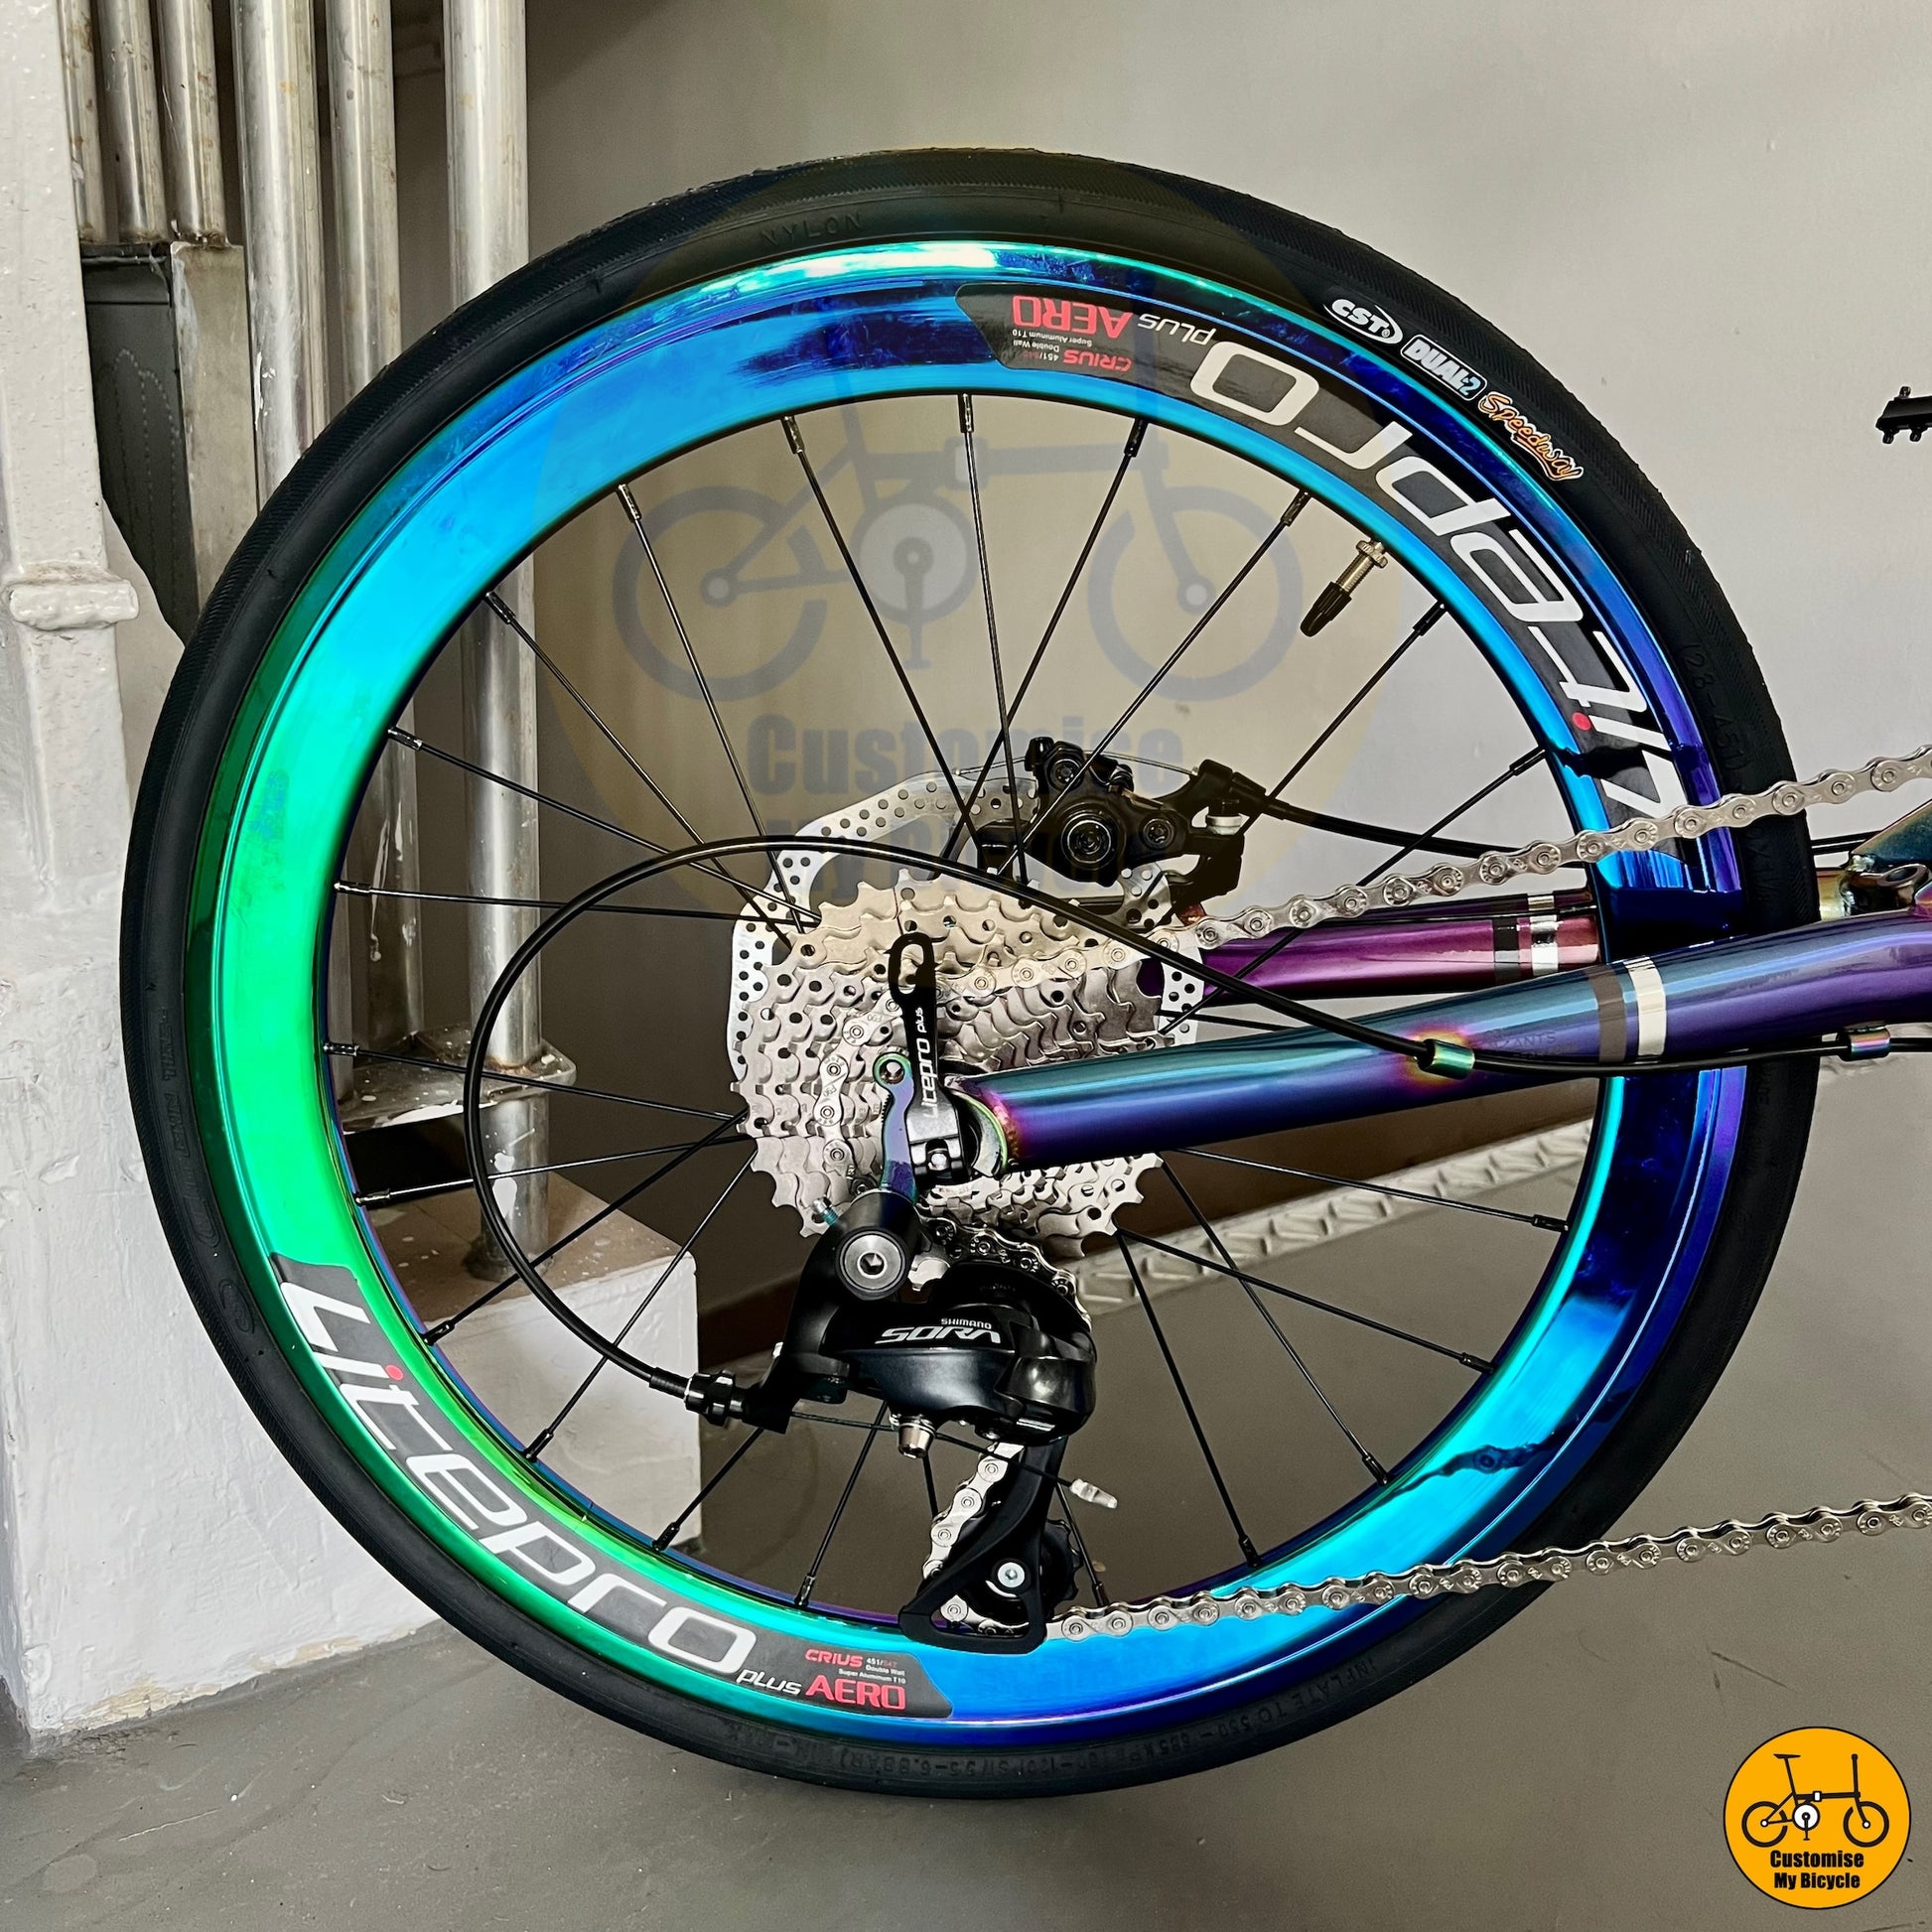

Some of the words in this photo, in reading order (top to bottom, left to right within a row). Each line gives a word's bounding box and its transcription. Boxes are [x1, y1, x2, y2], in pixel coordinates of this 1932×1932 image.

[760, 209, 862, 246] NYLON
[1012, 295, 1133, 339] AERO
[1012, 329, 1028, 338] T10
[1029, 331, 1068, 344] Aluminum
[1138, 313, 1217, 345] plus
[1013, 340, 1031, 348] Wall
[1032, 342, 1059, 352] Double
[1069, 337, 1092, 347] Super
[1063, 349, 1133, 372] CRIUS
[1478, 392, 1584, 480] Speedway
[941, 1317, 992, 1329] SHIMANO
[875, 1325, 1001, 1344] SORA
[805, 1649, 863, 1668] CRIUS
[736, 1668, 802, 1696] plus
[805, 1674, 906, 1711] AERO
